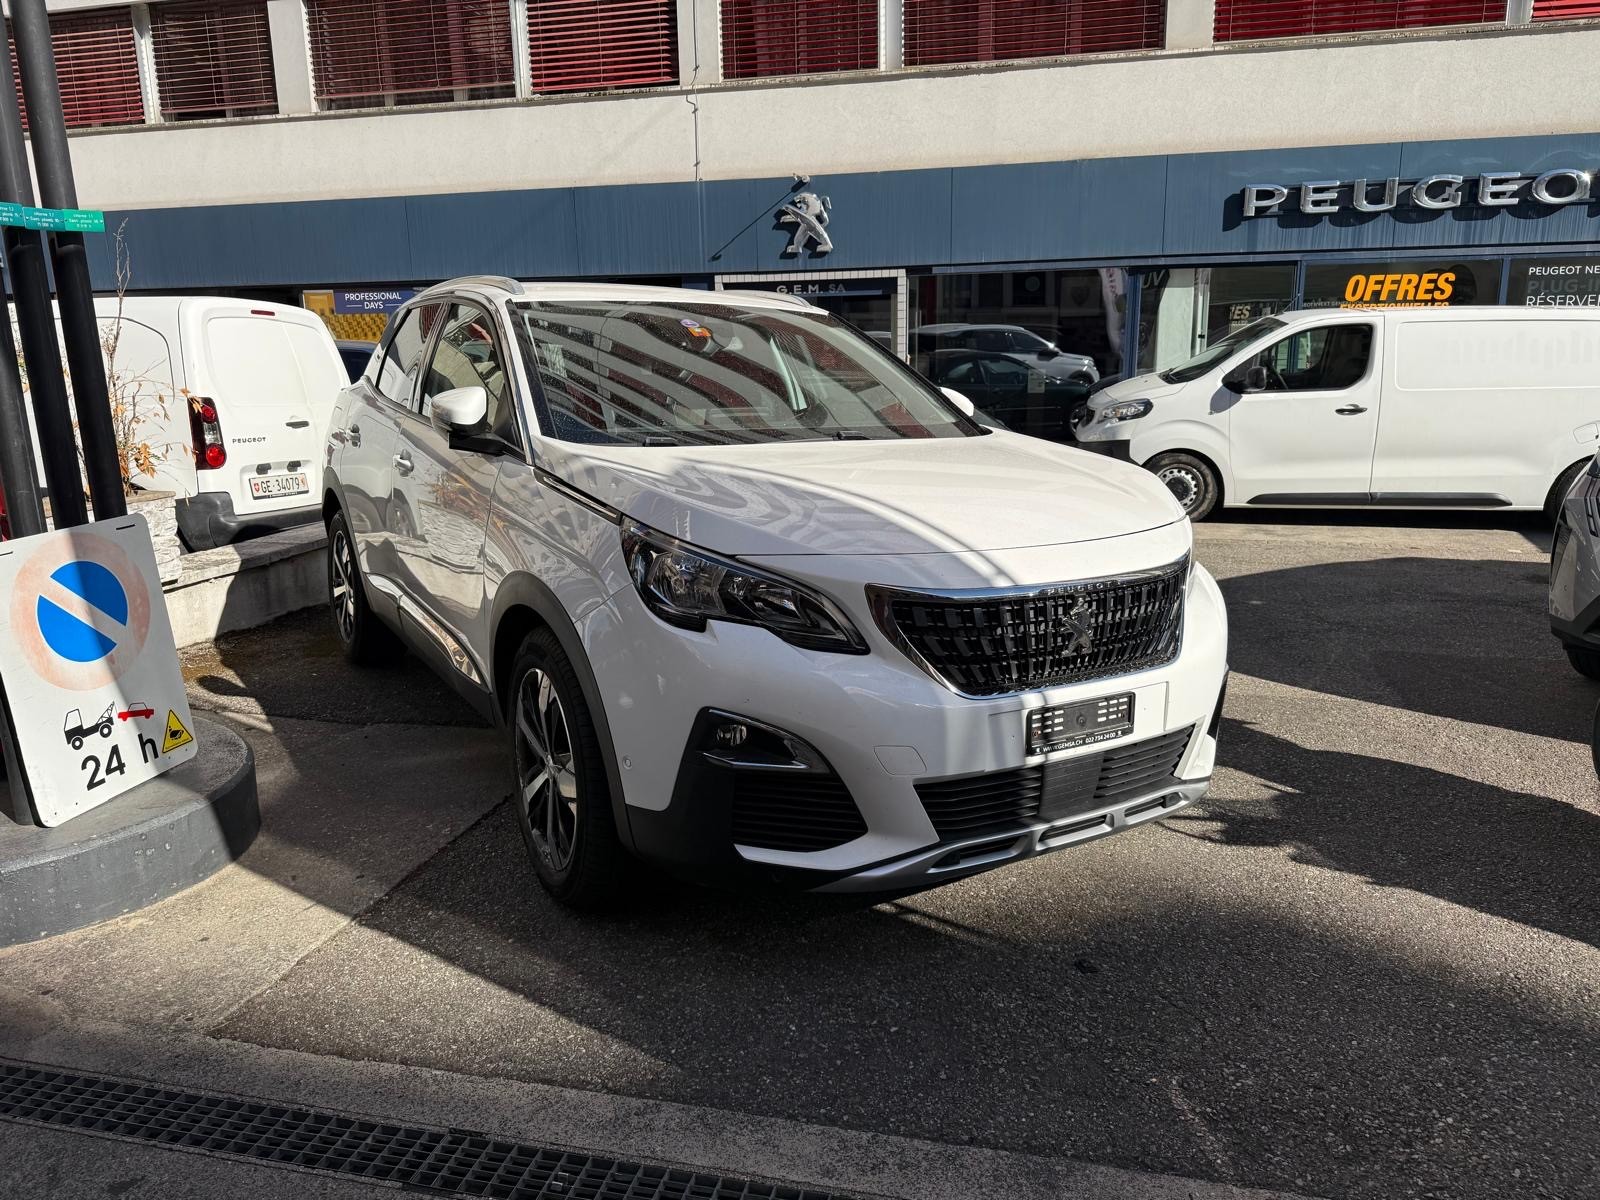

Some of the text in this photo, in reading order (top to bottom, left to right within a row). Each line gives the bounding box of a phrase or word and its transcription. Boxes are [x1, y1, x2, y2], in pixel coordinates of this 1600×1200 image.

[1243, 169, 1592, 217] PEUGEO
[1528, 265, 1582, 276] PEUGEOT
[776, 283, 846, 294] G.E.M. SA
[1344, 272, 1455, 302] OFFRES
[345, 292, 402, 301] PROFESSIONAL
[1526, 292, 1600, 307] RÉSERVE
[364, 301, 384, 309] DAYS
[232, 436, 266, 444] PEUGEOT
[1047, 581, 1111, 596] PEUGEOT
[81, 733, 159, 791] 24 h
